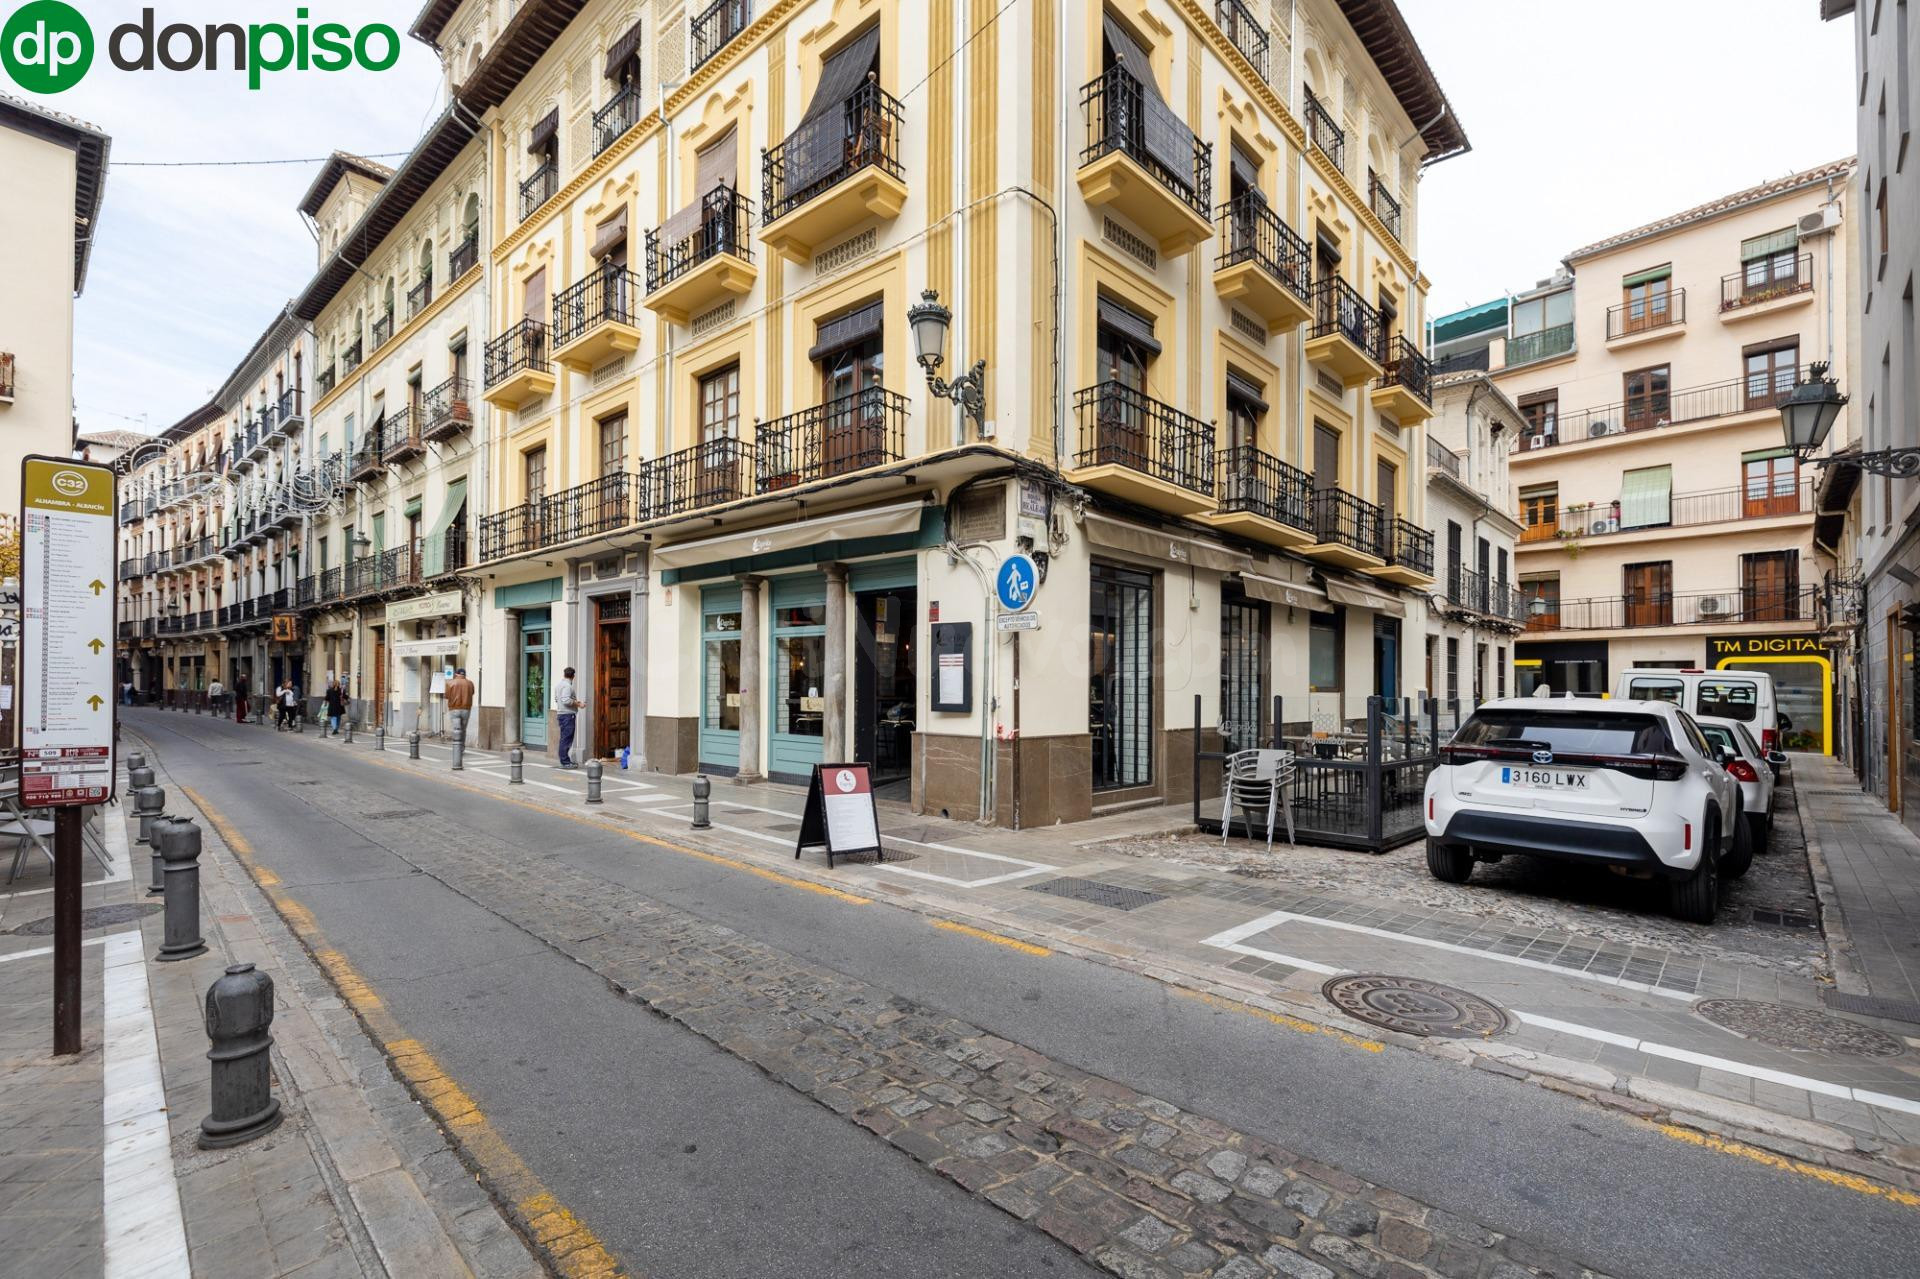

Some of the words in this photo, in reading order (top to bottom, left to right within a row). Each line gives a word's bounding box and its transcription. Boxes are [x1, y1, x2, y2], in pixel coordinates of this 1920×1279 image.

[57, 478, 84, 489] C32
[34, 498, 71, 507] ALHAMBRA
[1713, 640, 1742, 652] TM
[1748, 638, 1829, 652] DIGITAL
[1513, 770, 1550, 784] 3160
[1556, 774, 1585, 787] LWX
